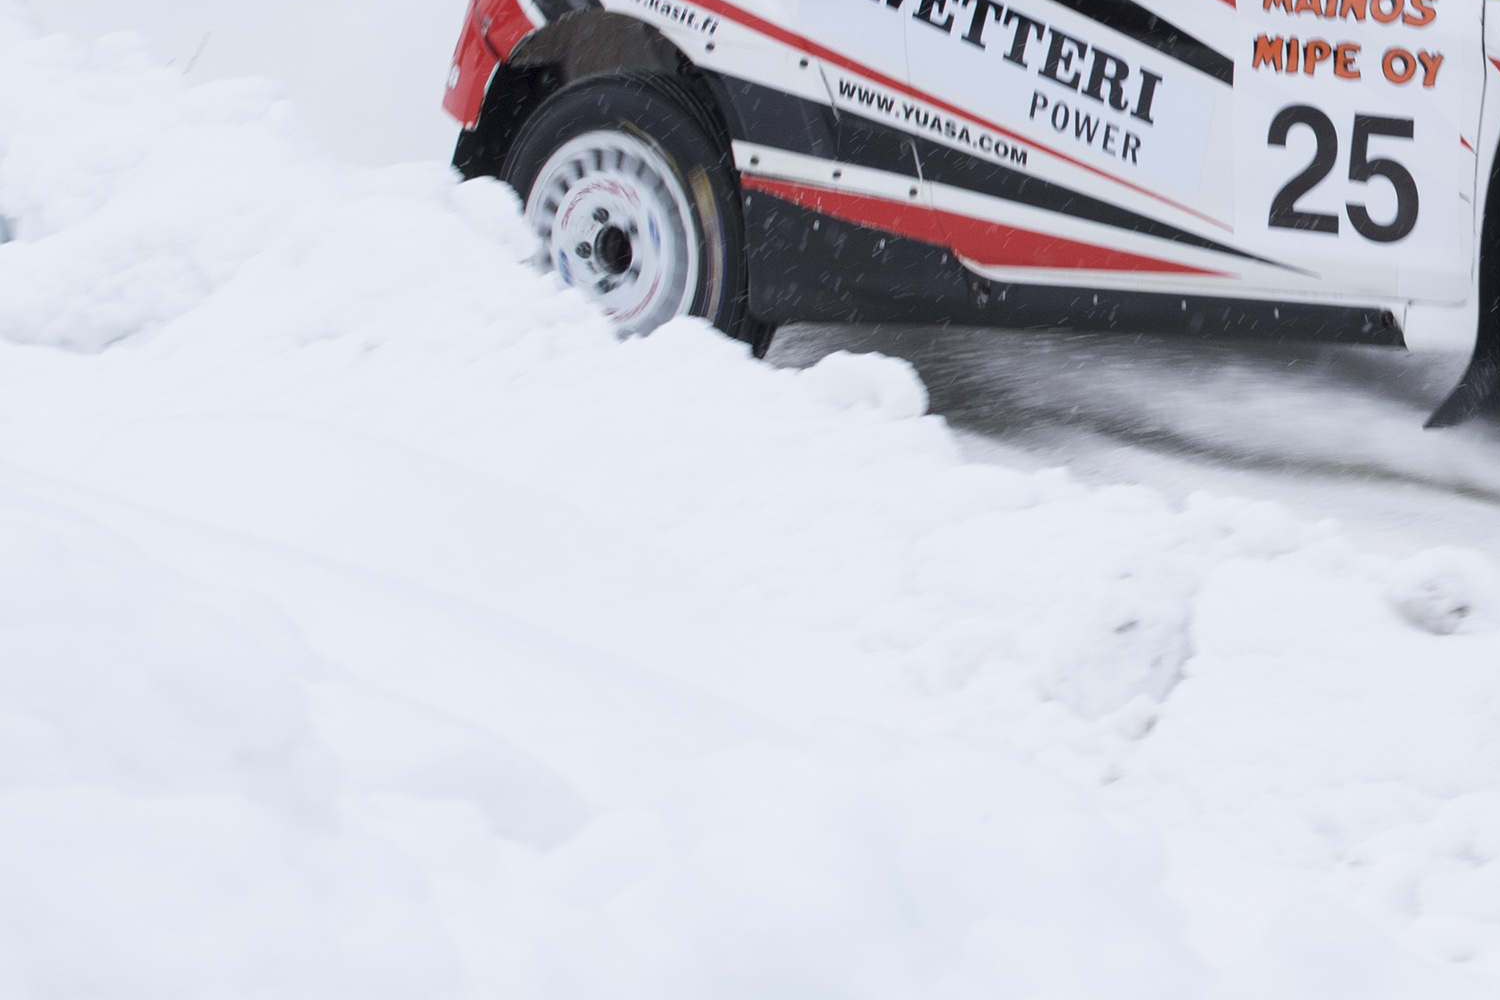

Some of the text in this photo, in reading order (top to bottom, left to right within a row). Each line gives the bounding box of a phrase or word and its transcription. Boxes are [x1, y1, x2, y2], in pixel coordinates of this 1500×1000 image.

[1252, 33, 1445, 89] MIPE OY
[837, 77, 1029, 167] WWW.YUASA.COM
[1028, 88, 1143, 168] POWER
[1266, 103, 1420, 244] 25
